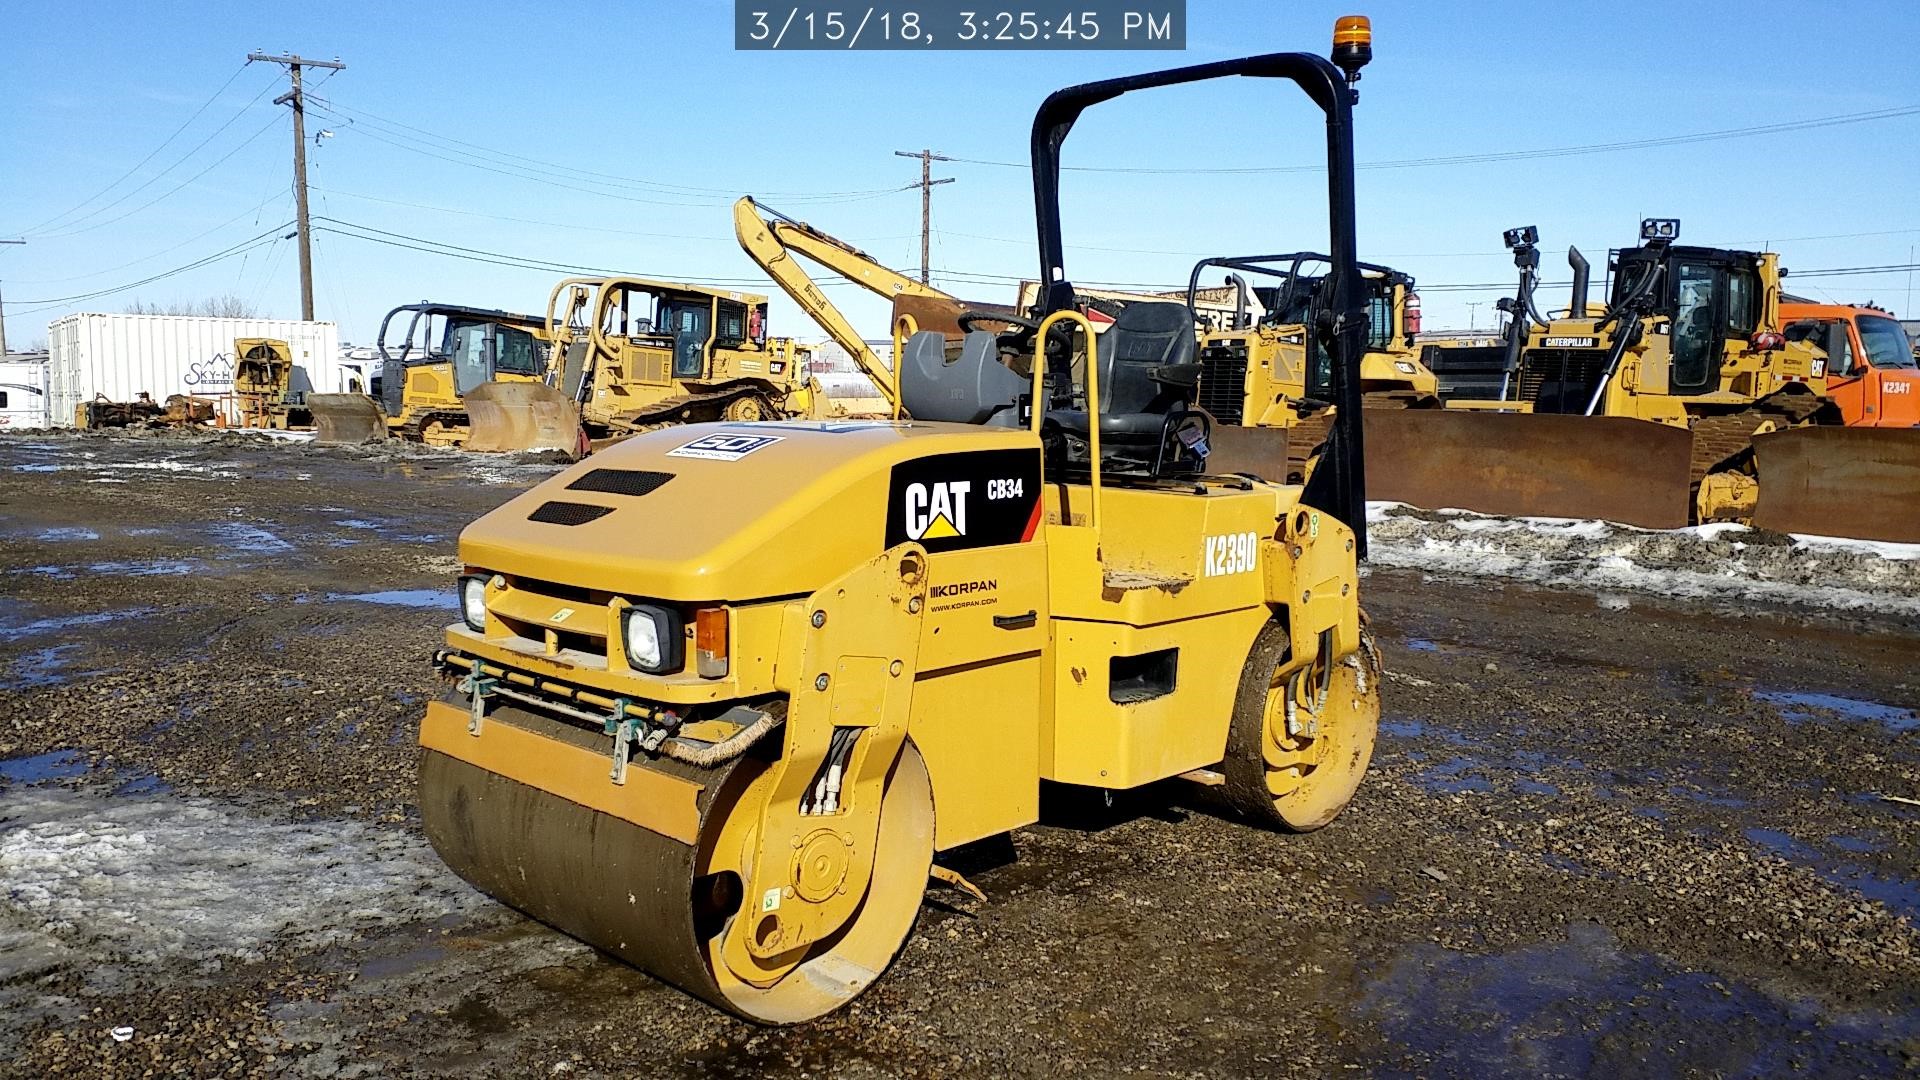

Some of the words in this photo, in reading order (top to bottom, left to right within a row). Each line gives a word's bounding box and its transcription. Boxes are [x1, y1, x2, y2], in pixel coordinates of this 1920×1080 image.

[1545, 337, 1593, 348] CATERPILLAR
[1882, 381, 1911, 395] K2341
[987, 477, 1024, 501] CB34
[905, 480, 971, 541] CAT
[1205, 531, 1257, 578] K2390
[932, 578, 998, 599] KORPAN
[930, 597, 998, 613] WWW.KORPAN.COM
